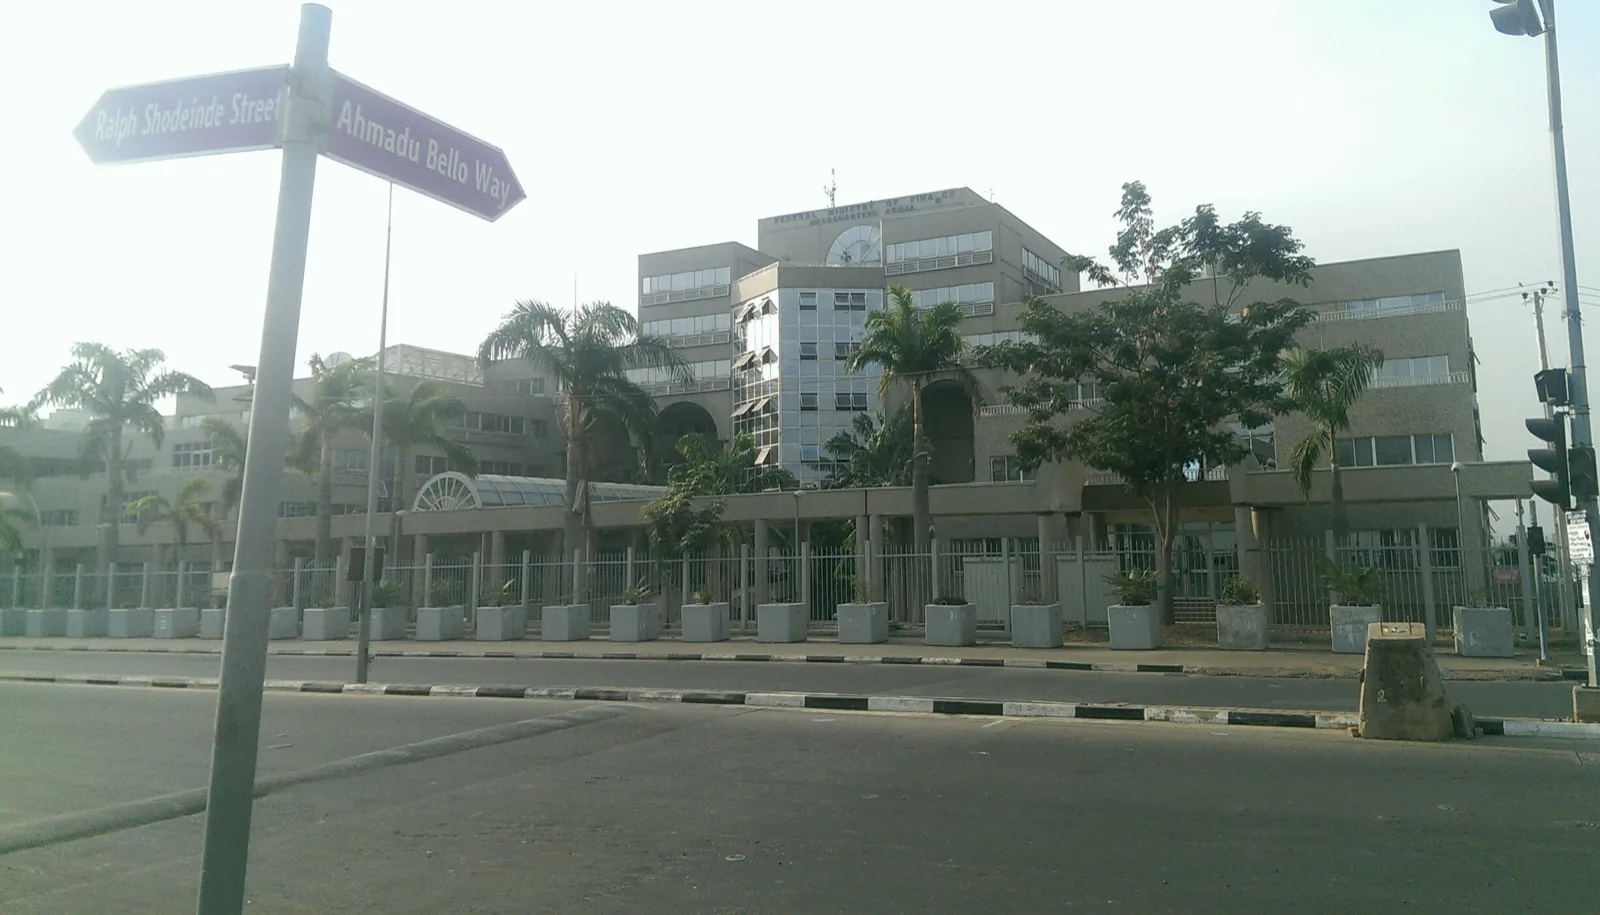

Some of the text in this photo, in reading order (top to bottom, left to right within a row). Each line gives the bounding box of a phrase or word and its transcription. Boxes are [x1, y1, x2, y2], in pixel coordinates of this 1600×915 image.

[94, 90, 282, 148] Ralph Shodeinde Street
[337, 100, 511, 210] Ahmadu Bello Way
